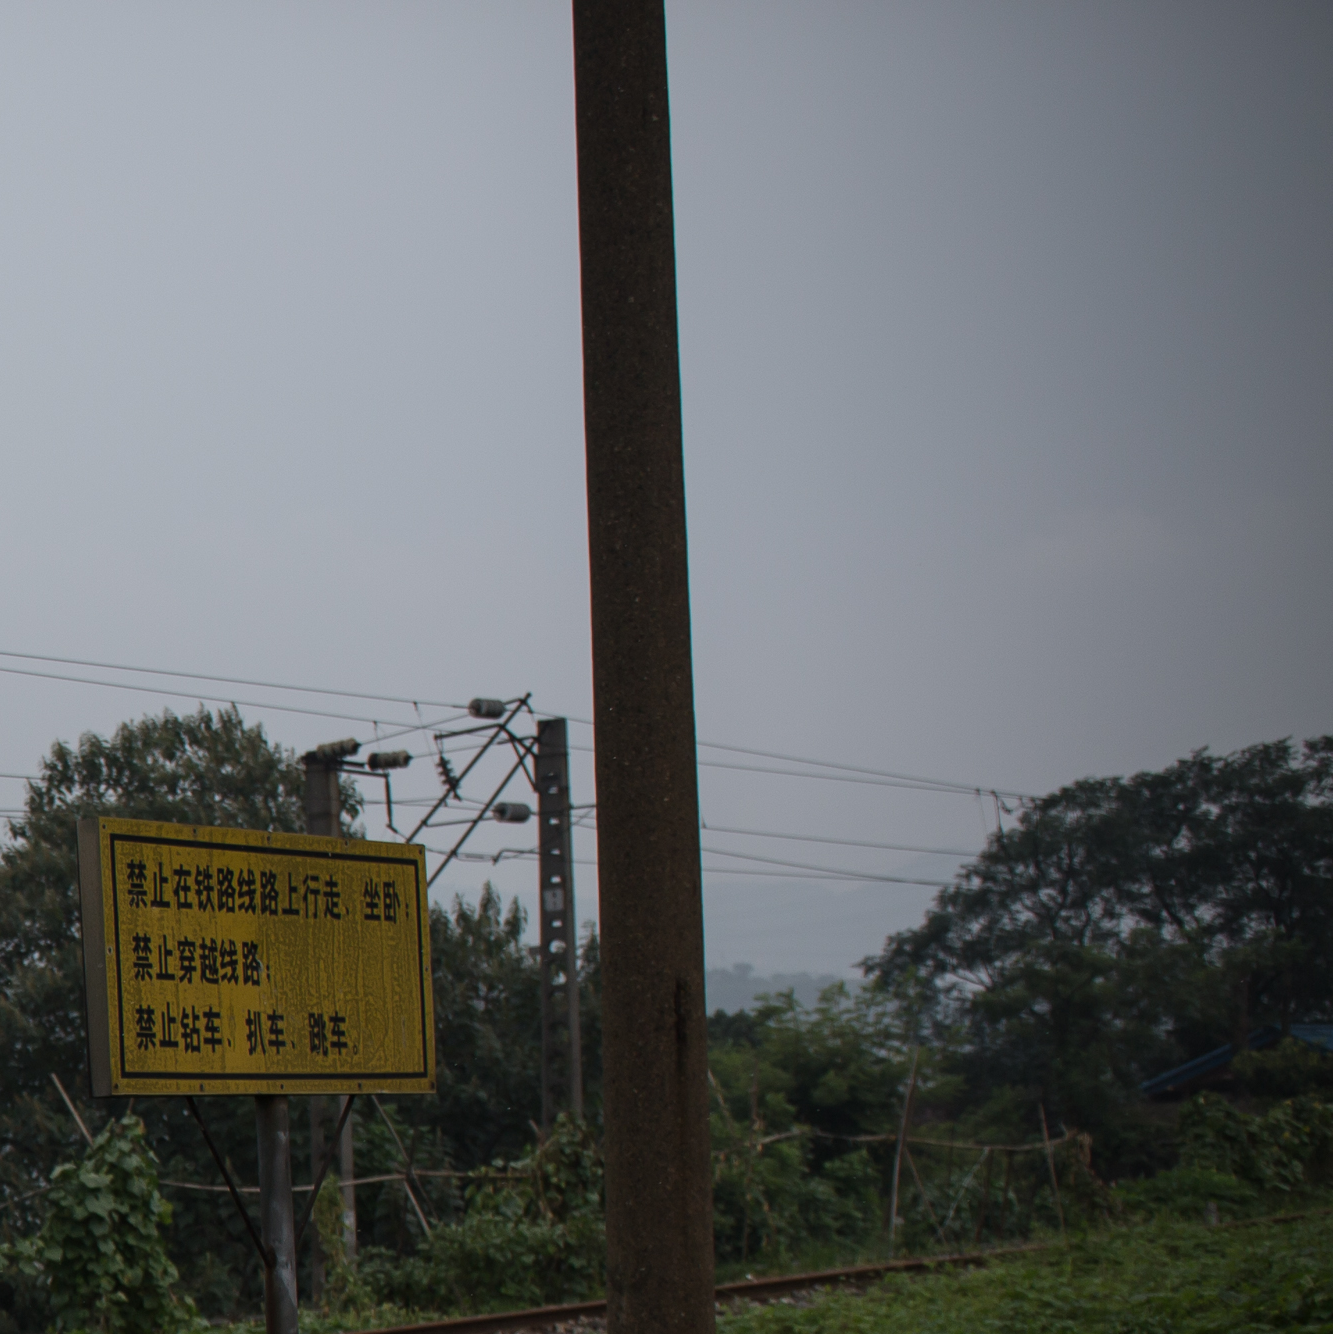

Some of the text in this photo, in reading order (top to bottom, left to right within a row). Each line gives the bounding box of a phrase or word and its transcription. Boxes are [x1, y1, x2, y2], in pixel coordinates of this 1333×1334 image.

[135, 1003, 358, 1056] 禁止钻车、扒车、跳车。
